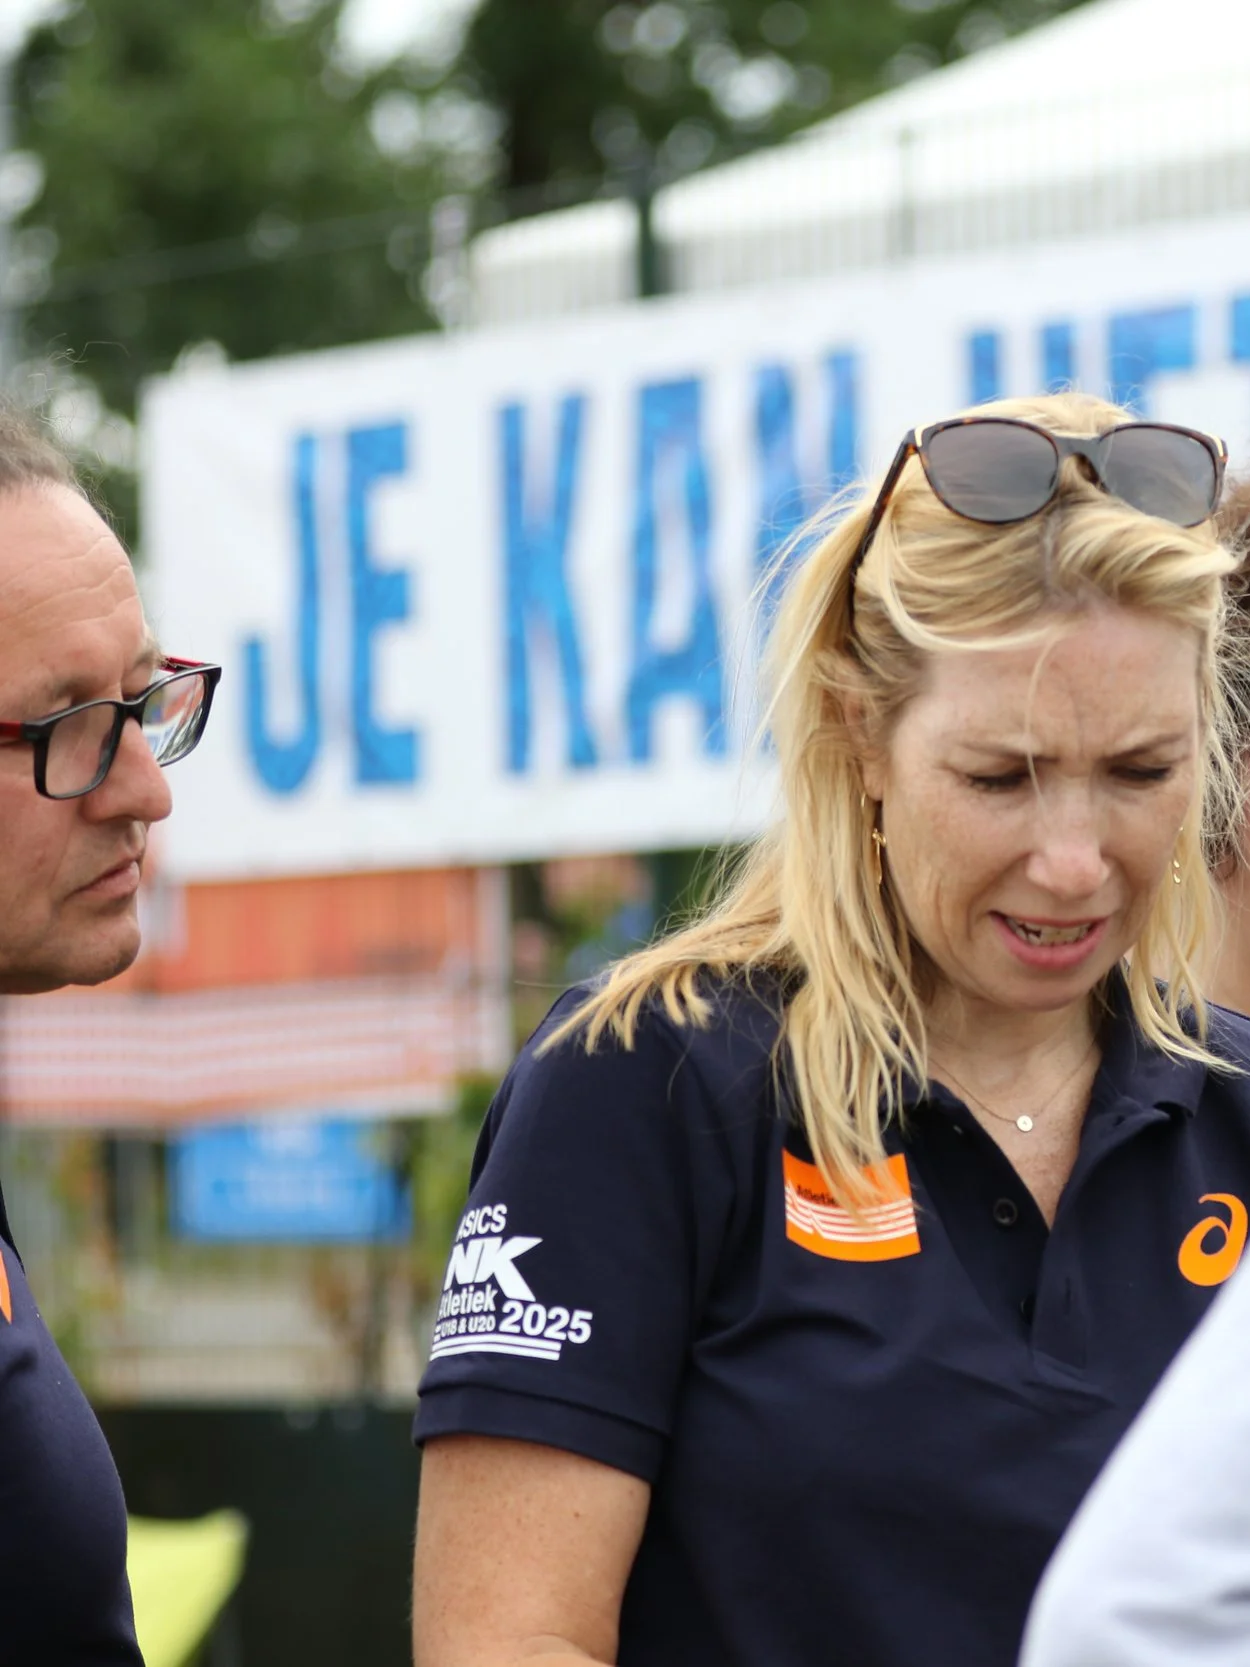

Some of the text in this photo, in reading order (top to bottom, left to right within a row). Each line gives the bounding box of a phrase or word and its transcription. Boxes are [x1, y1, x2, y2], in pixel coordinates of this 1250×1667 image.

[240, 415, 420, 796] JE
[443, 1235, 544, 1302] NK
[467, 1314, 497, 1334] U20
[498, 1300, 594, 1345] 2025
